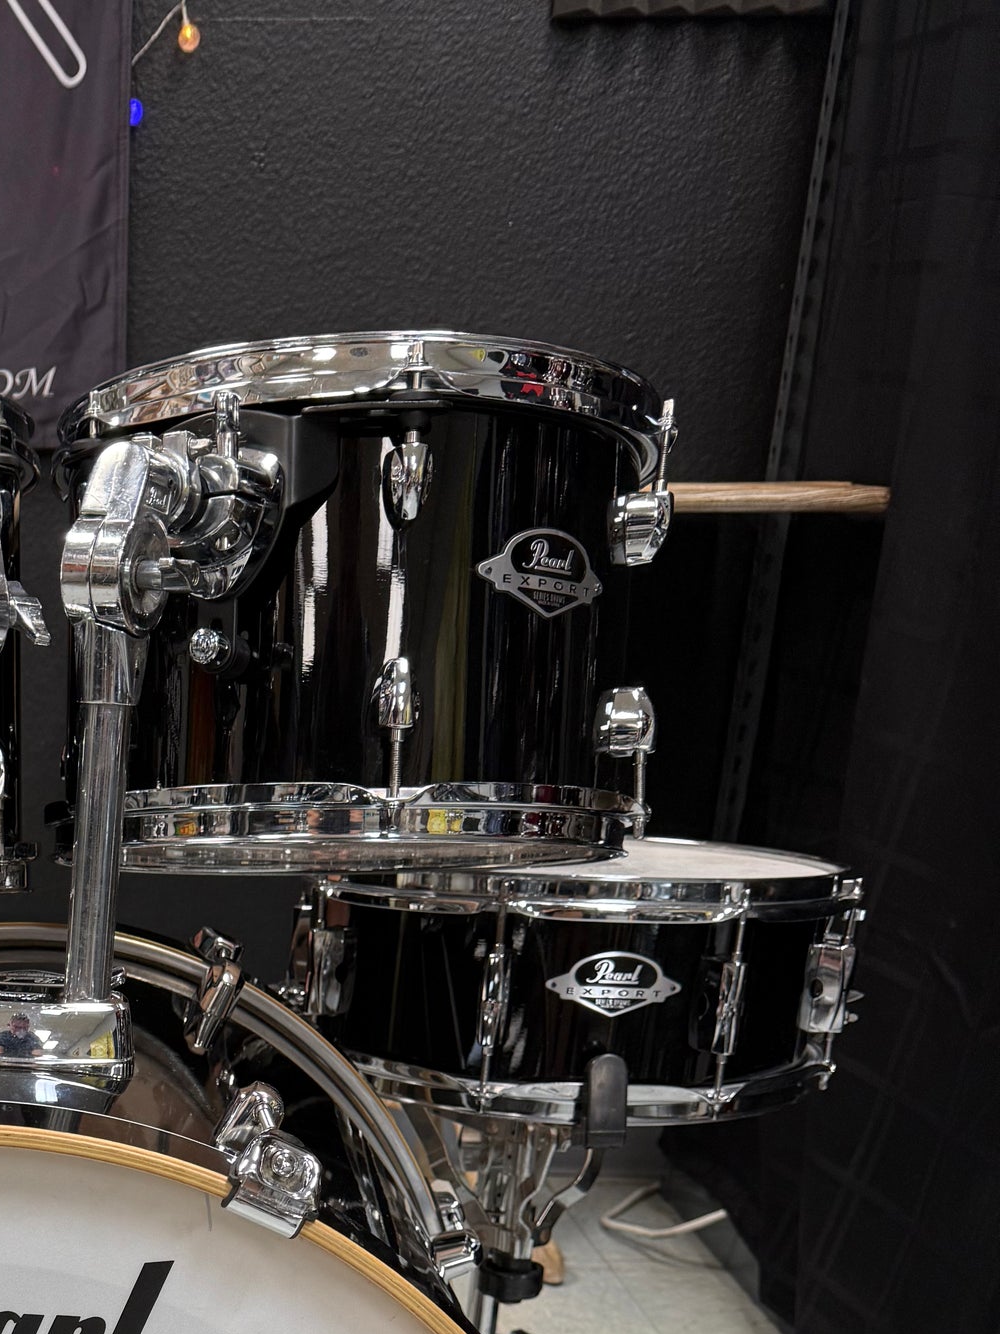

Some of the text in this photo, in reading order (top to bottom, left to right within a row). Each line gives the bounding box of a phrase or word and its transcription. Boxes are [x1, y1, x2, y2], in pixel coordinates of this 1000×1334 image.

[521, 538, 575, 575] Pearl
[503, 574, 589, 597] EXPORT
[586, 959, 643, 985] Pearl
[566, 986, 661, 998] EXPORT
